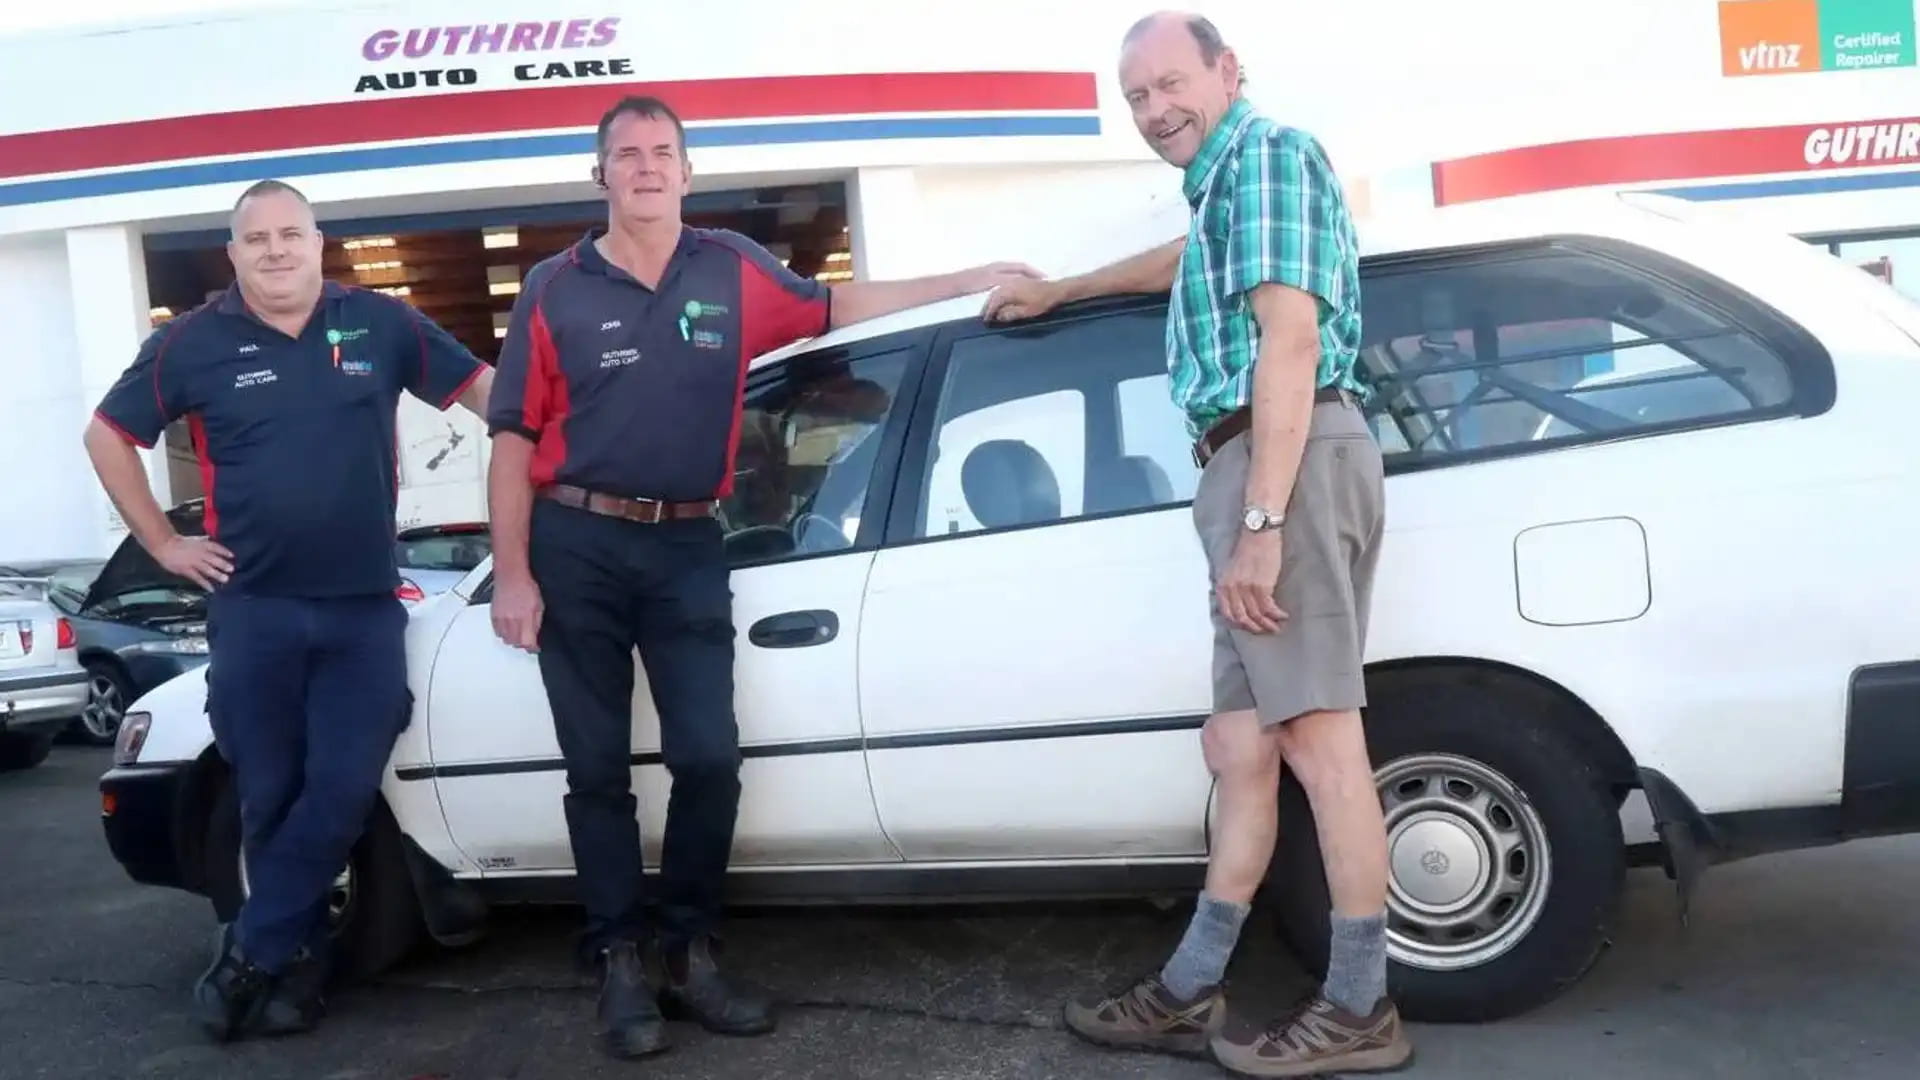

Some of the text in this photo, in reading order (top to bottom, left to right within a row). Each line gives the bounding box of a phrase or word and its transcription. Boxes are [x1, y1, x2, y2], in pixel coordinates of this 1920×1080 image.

[362, 17, 621, 61] GUTHRIES
[1834, 32, 1901, 48] Certified
[1739, 40, 1802, 69] vtnz
[1836, 51, 1900, 69] Repairer
[354, 58, 635, 92] AUTO CARE
[600, 358, 621, 368] AUTO
[235, 378, 256, 389] AUTO
